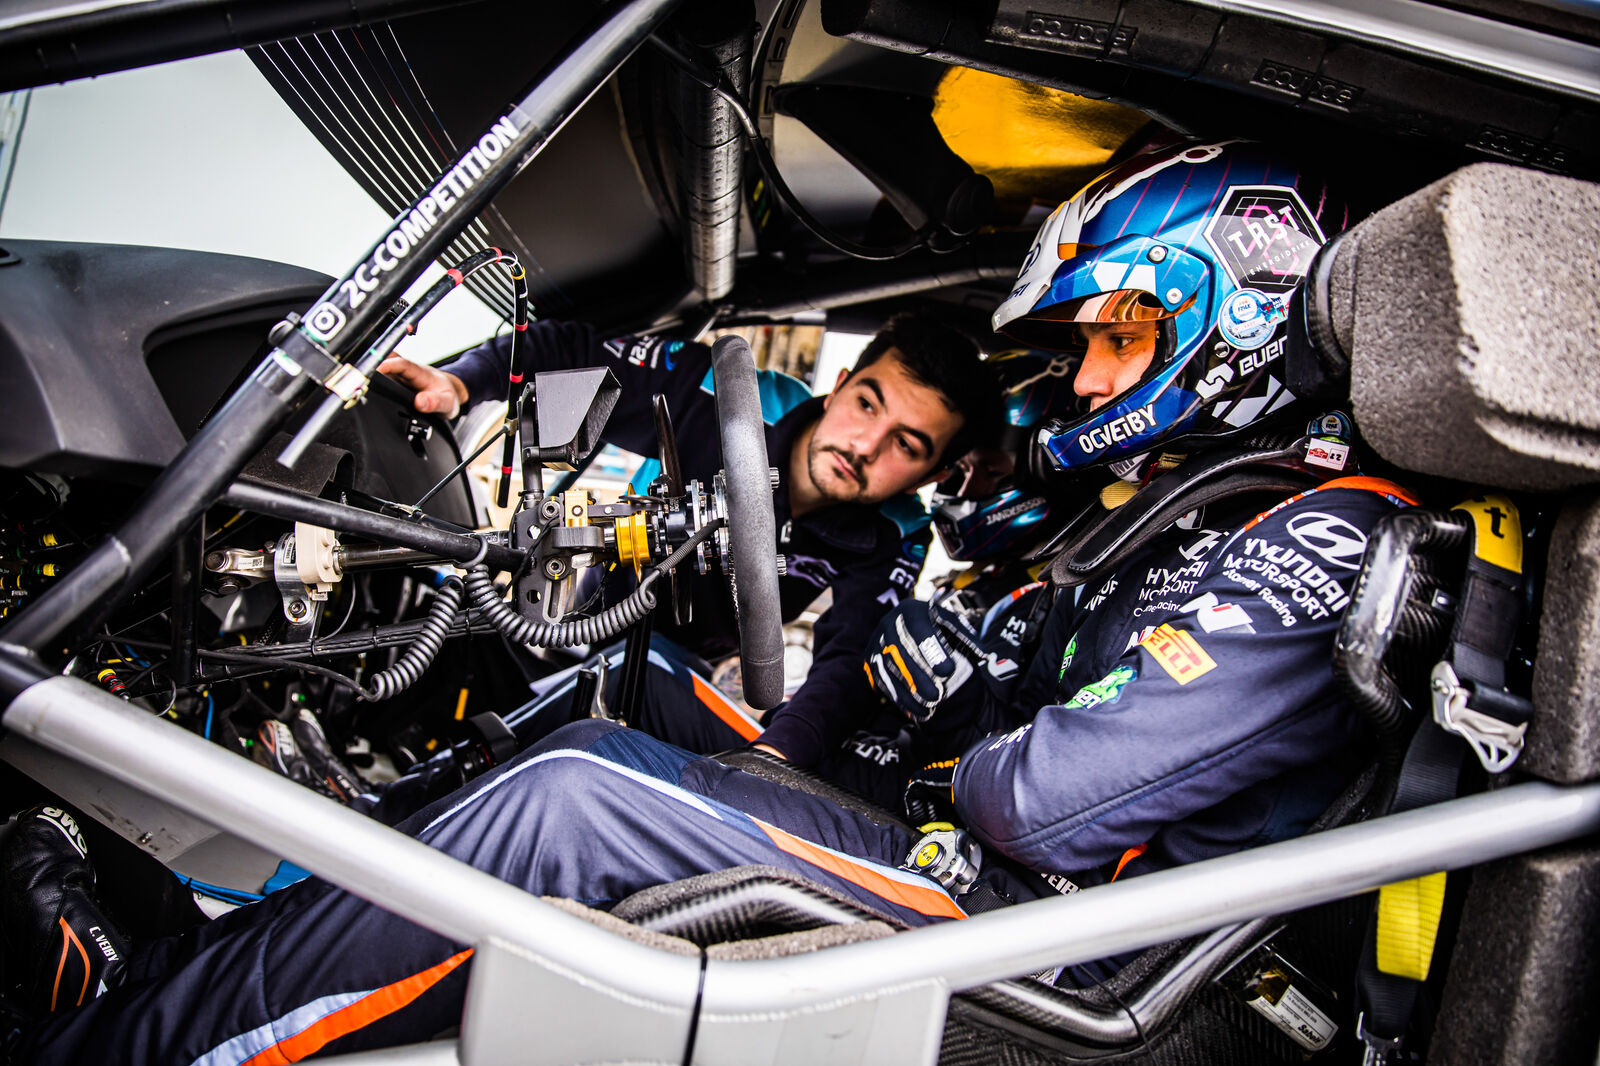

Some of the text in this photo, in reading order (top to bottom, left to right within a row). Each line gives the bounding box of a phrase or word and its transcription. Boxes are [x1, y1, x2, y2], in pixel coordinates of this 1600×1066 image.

[340, 115, 520, 309] 2C-COMPETITION
[1257, 586, 1298, 628] Racing
[42, 806, 88, 854] OMP
